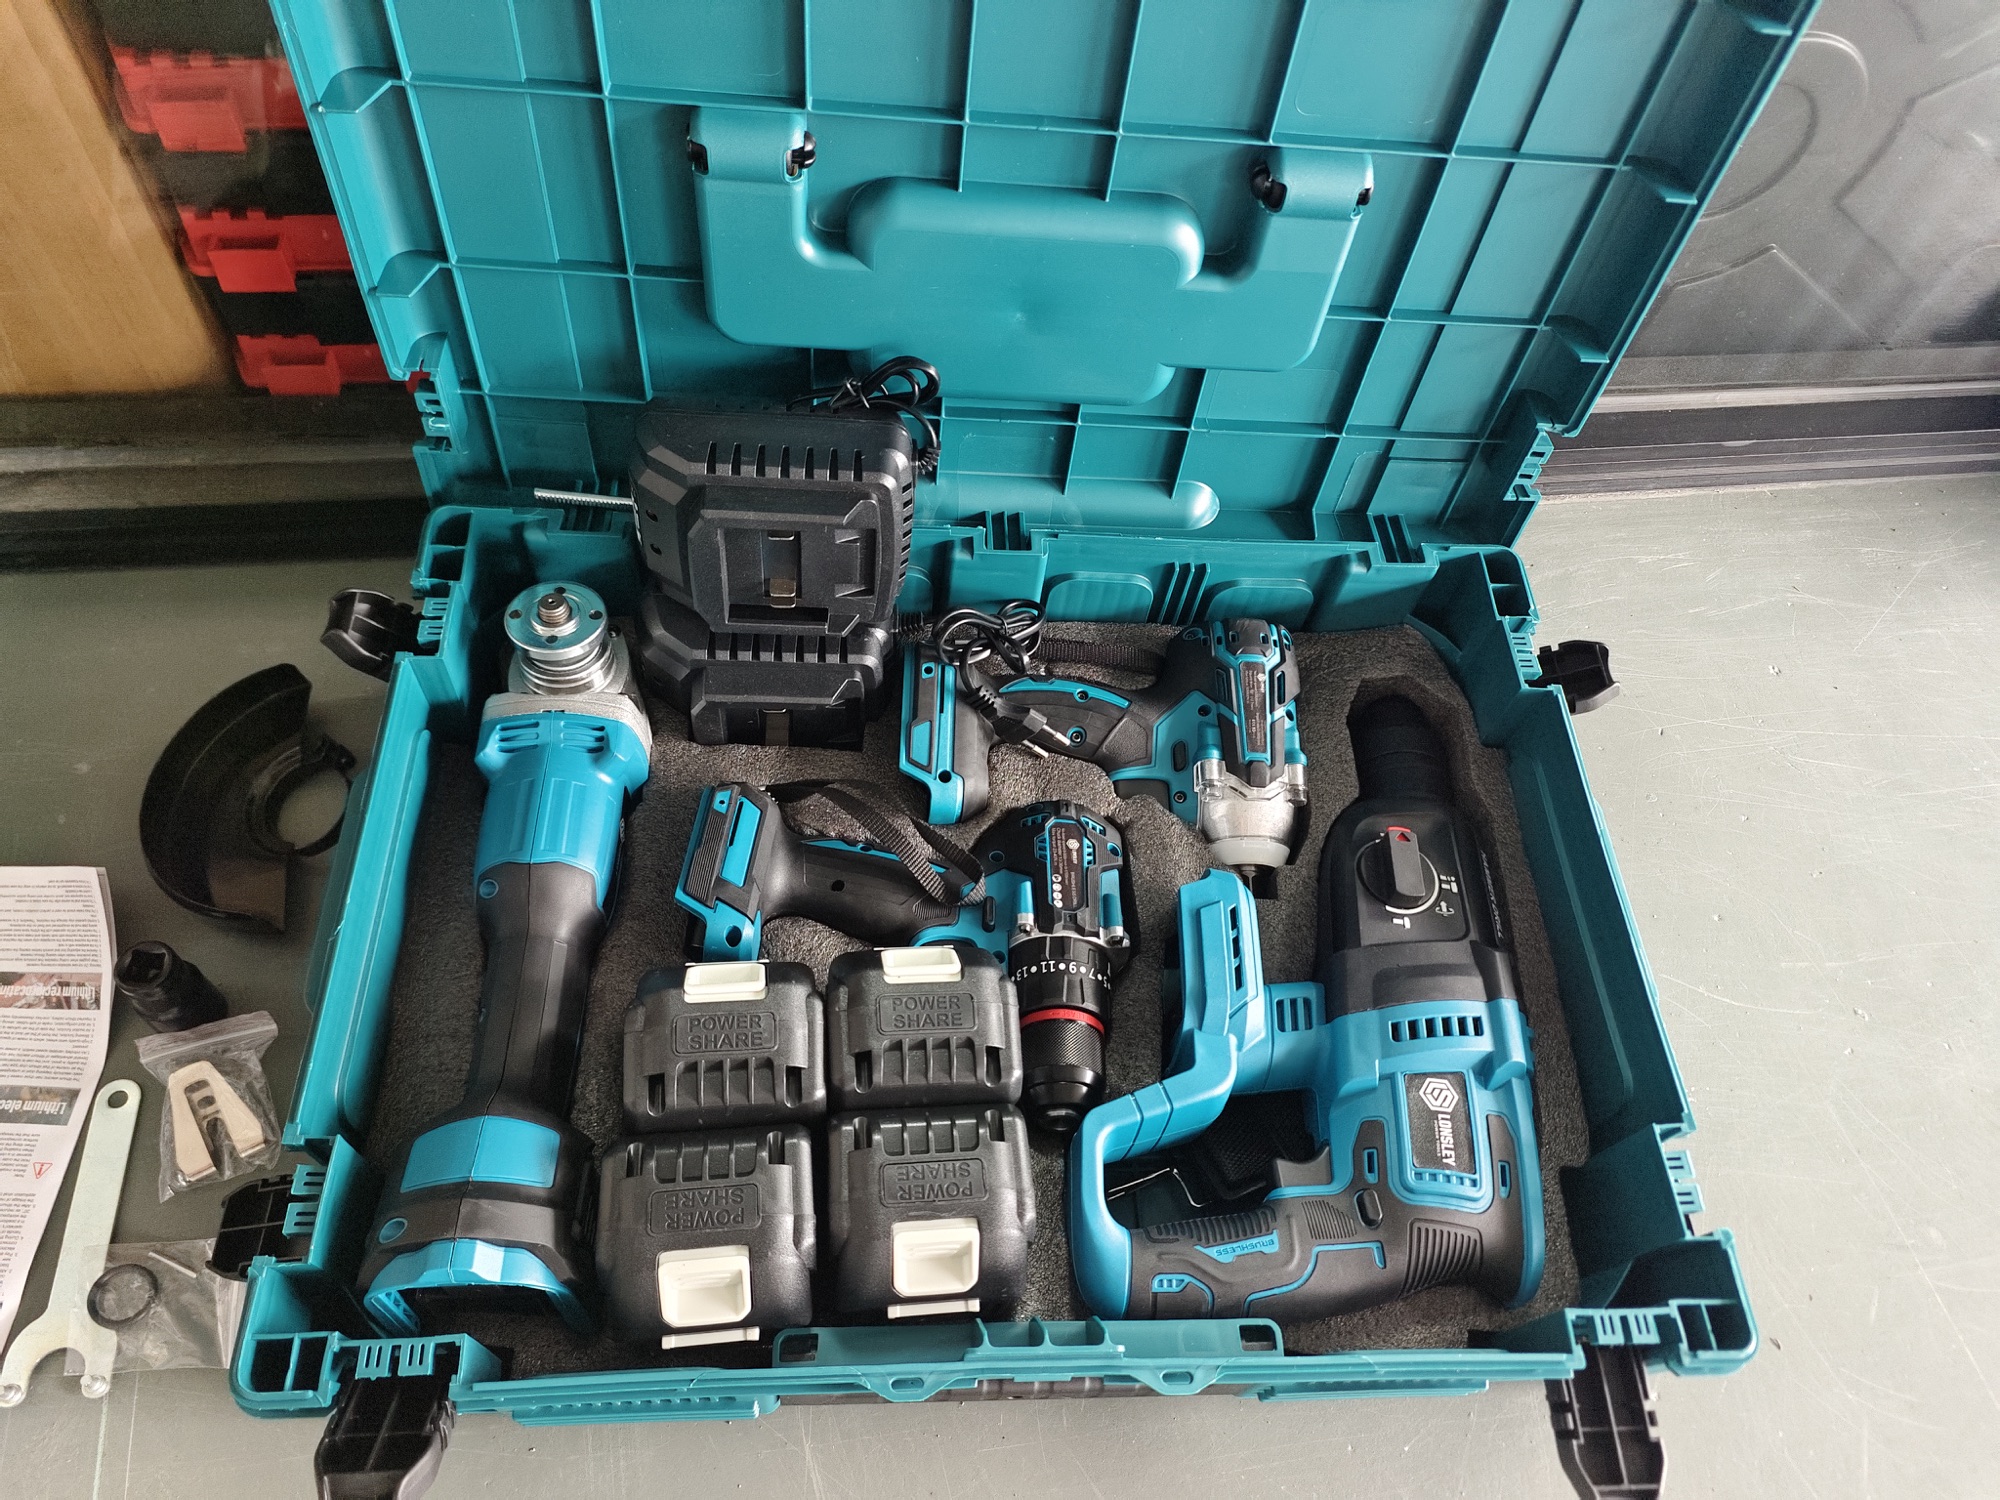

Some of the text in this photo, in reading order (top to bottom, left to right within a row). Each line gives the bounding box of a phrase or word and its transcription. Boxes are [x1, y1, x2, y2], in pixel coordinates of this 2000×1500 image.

[1016, 965, 1028, 981] 13
[1040, 960, 1056, 974] 11
[1069, 961, 1077, 974] 9
[1088, 967, 1096, 980] 7
[891, 995, 961, 1011] POWER
[688, 1014, 763, 1033] POWER
[893, 1010, 963, 1027] SHARE
[688, 1032, 764, 1051] SHARE
[23, 1100, 67, 1115] Lithium
[1437, 1113, 1456, 1166] LONSLEY
[897, 1162, 971, 1181] SHARE
[664, 1189, 744, 1210] SHARE
[897, 1180, 973, 1200] POWER
[665, 1208, 744, 1229] POWER
[1215, 1238, 1275, 1257] BRUSHLESS
